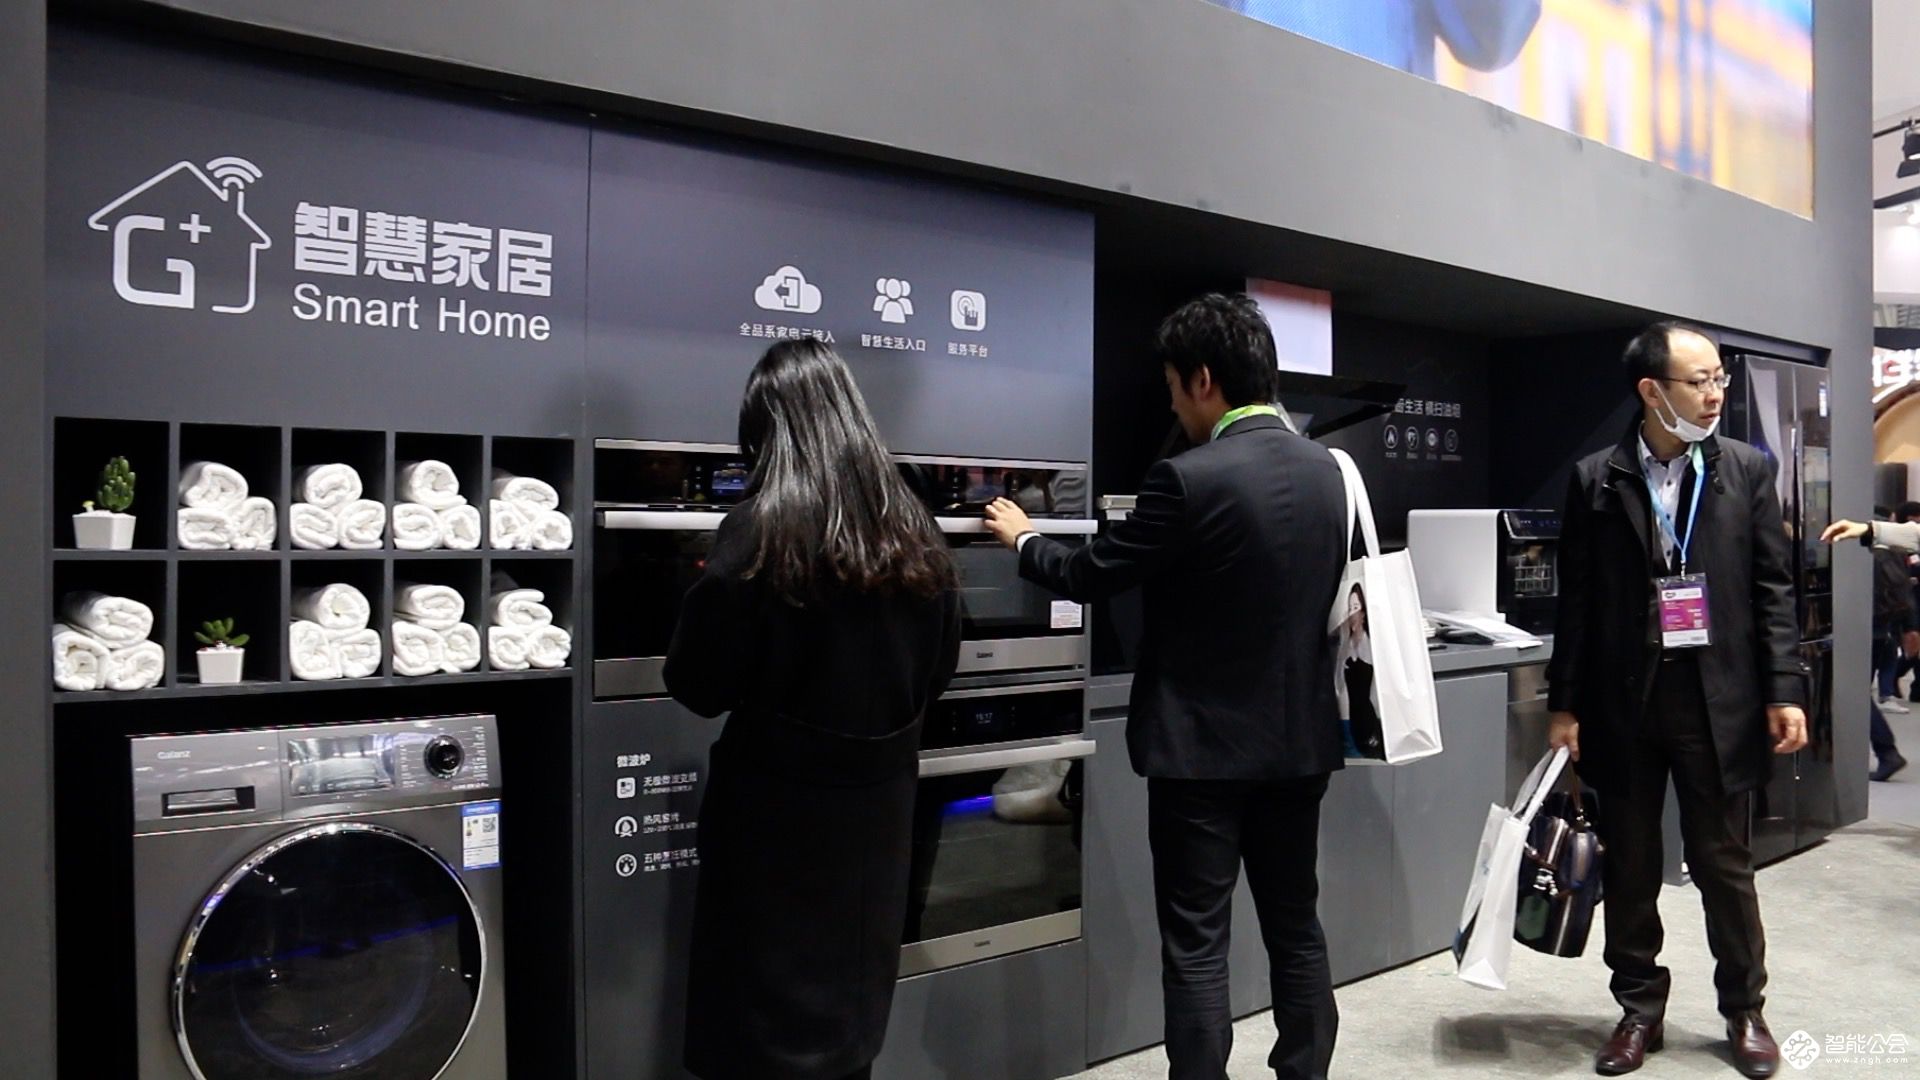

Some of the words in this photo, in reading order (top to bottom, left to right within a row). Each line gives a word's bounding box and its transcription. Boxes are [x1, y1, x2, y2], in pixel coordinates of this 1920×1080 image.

[294, 201, 553, 297] 智慧家居
[292, 283, 420, 330] Smart
[438, 297, 551, 341] Home
[861, 333, 926, 352] 智慧生活入口
[947, 342, 988, 358] 服务平台
